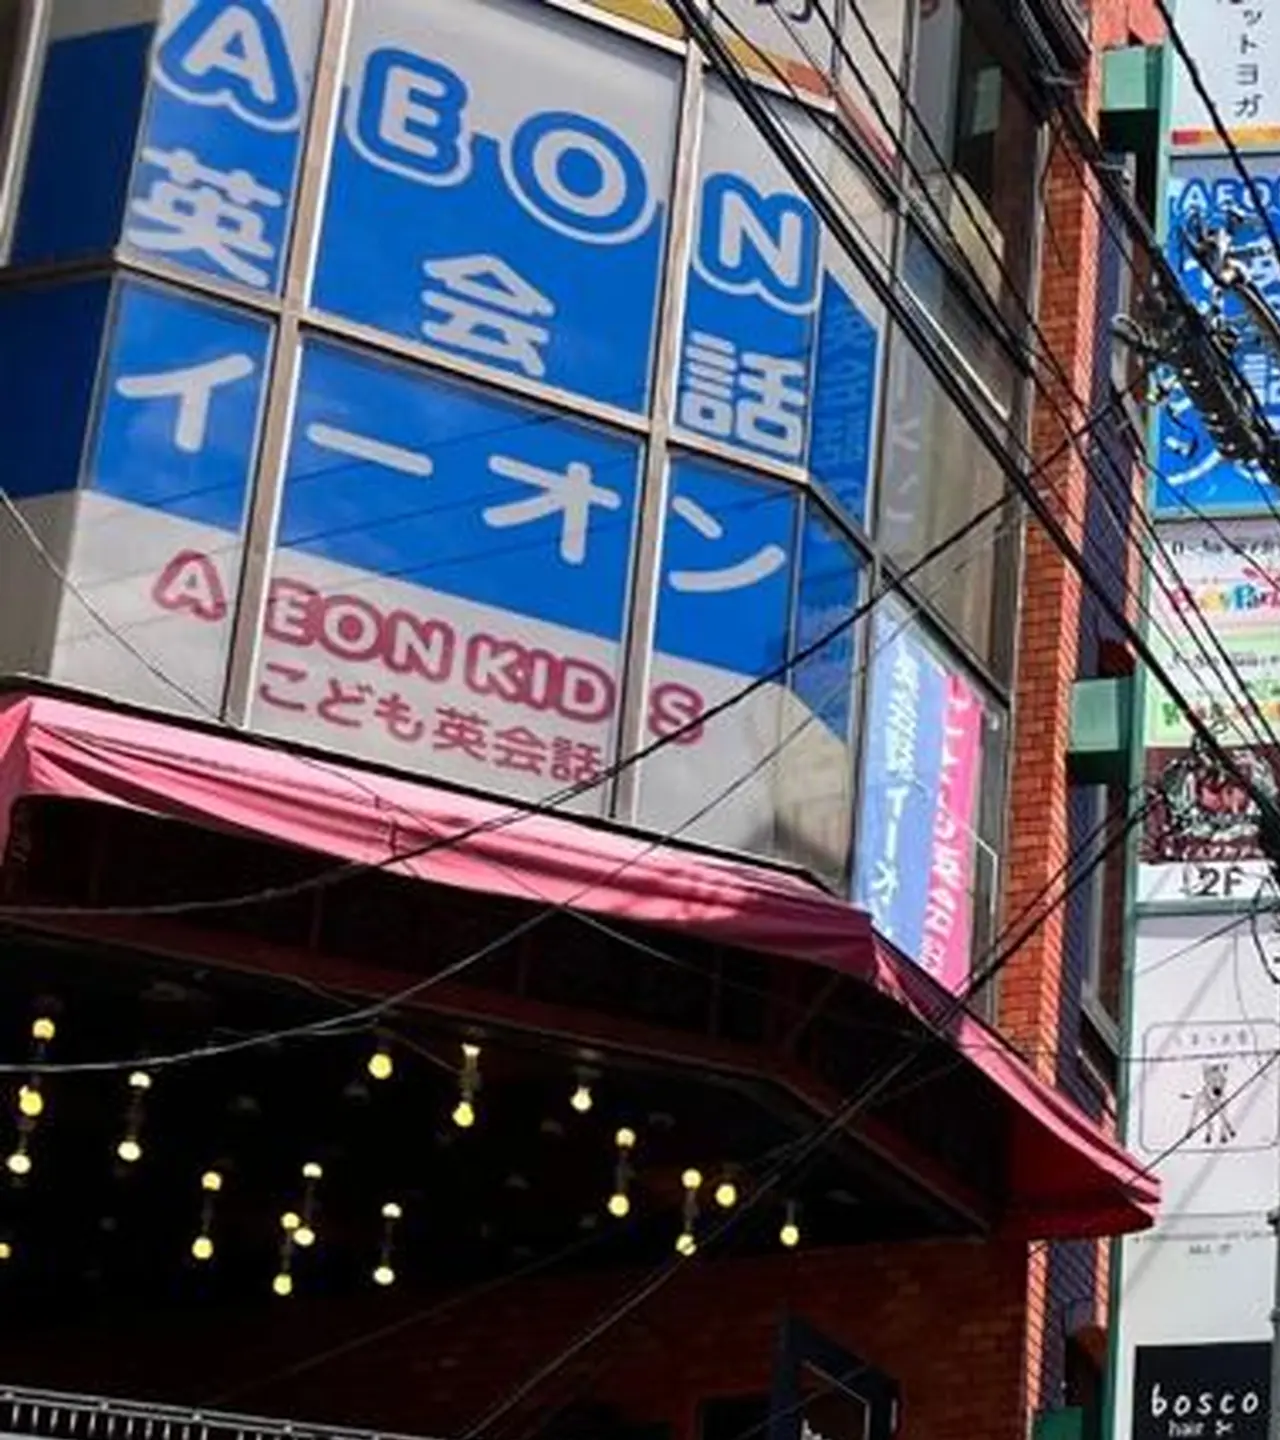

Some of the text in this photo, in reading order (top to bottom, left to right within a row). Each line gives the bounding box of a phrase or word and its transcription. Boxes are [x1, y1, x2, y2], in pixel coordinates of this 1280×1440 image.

[165, 0, 818, 298] AEON
[126, 147, 805, 456] 英会話
[117, 353, 787, 592] イーオン
[153, 550, 704, 749] AEON KIDS
[261, 661, 604, 790] こども英会話
[1150, 1382, 1259, 1417] bosco
[1168, 1417, 1205, 1439] hair
